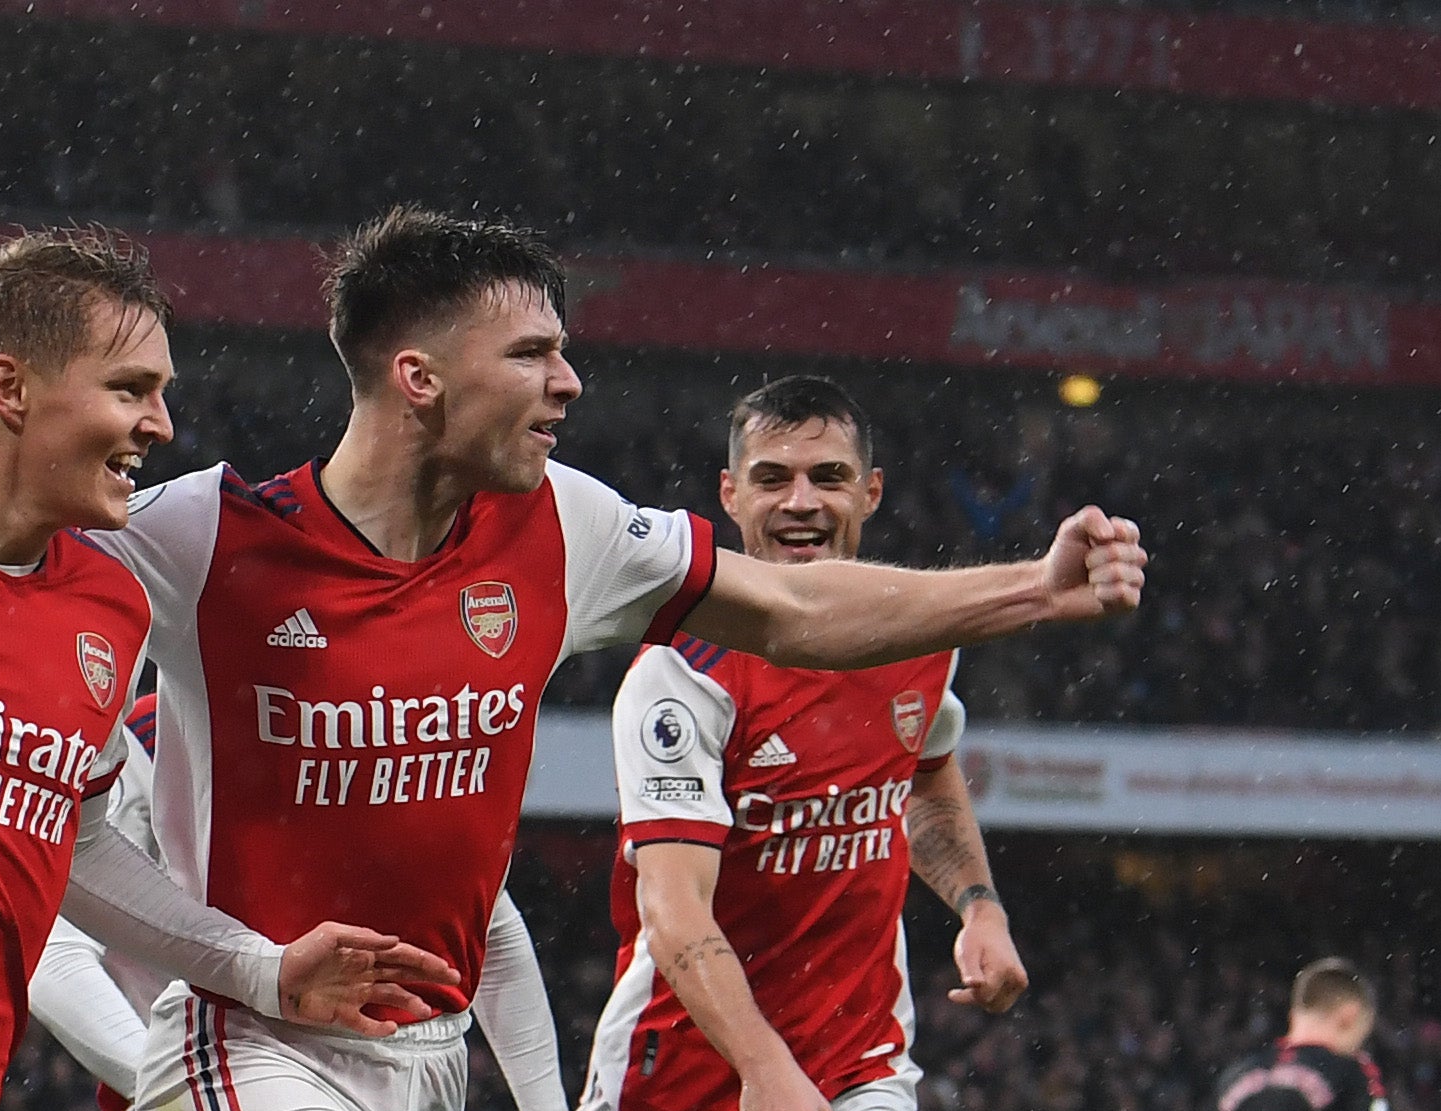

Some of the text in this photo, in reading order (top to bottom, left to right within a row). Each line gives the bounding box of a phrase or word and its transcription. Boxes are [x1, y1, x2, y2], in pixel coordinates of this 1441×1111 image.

[467, 594, 509, 608] Arsenal
[267, 632, 328, 648] adidas
[253, 683, 525, 749] Emirates
[295, 747, 491, 806] FLY BETTER
[735, 777, 913, 834] Emirate
[756, 835, 811, 875] FLY
